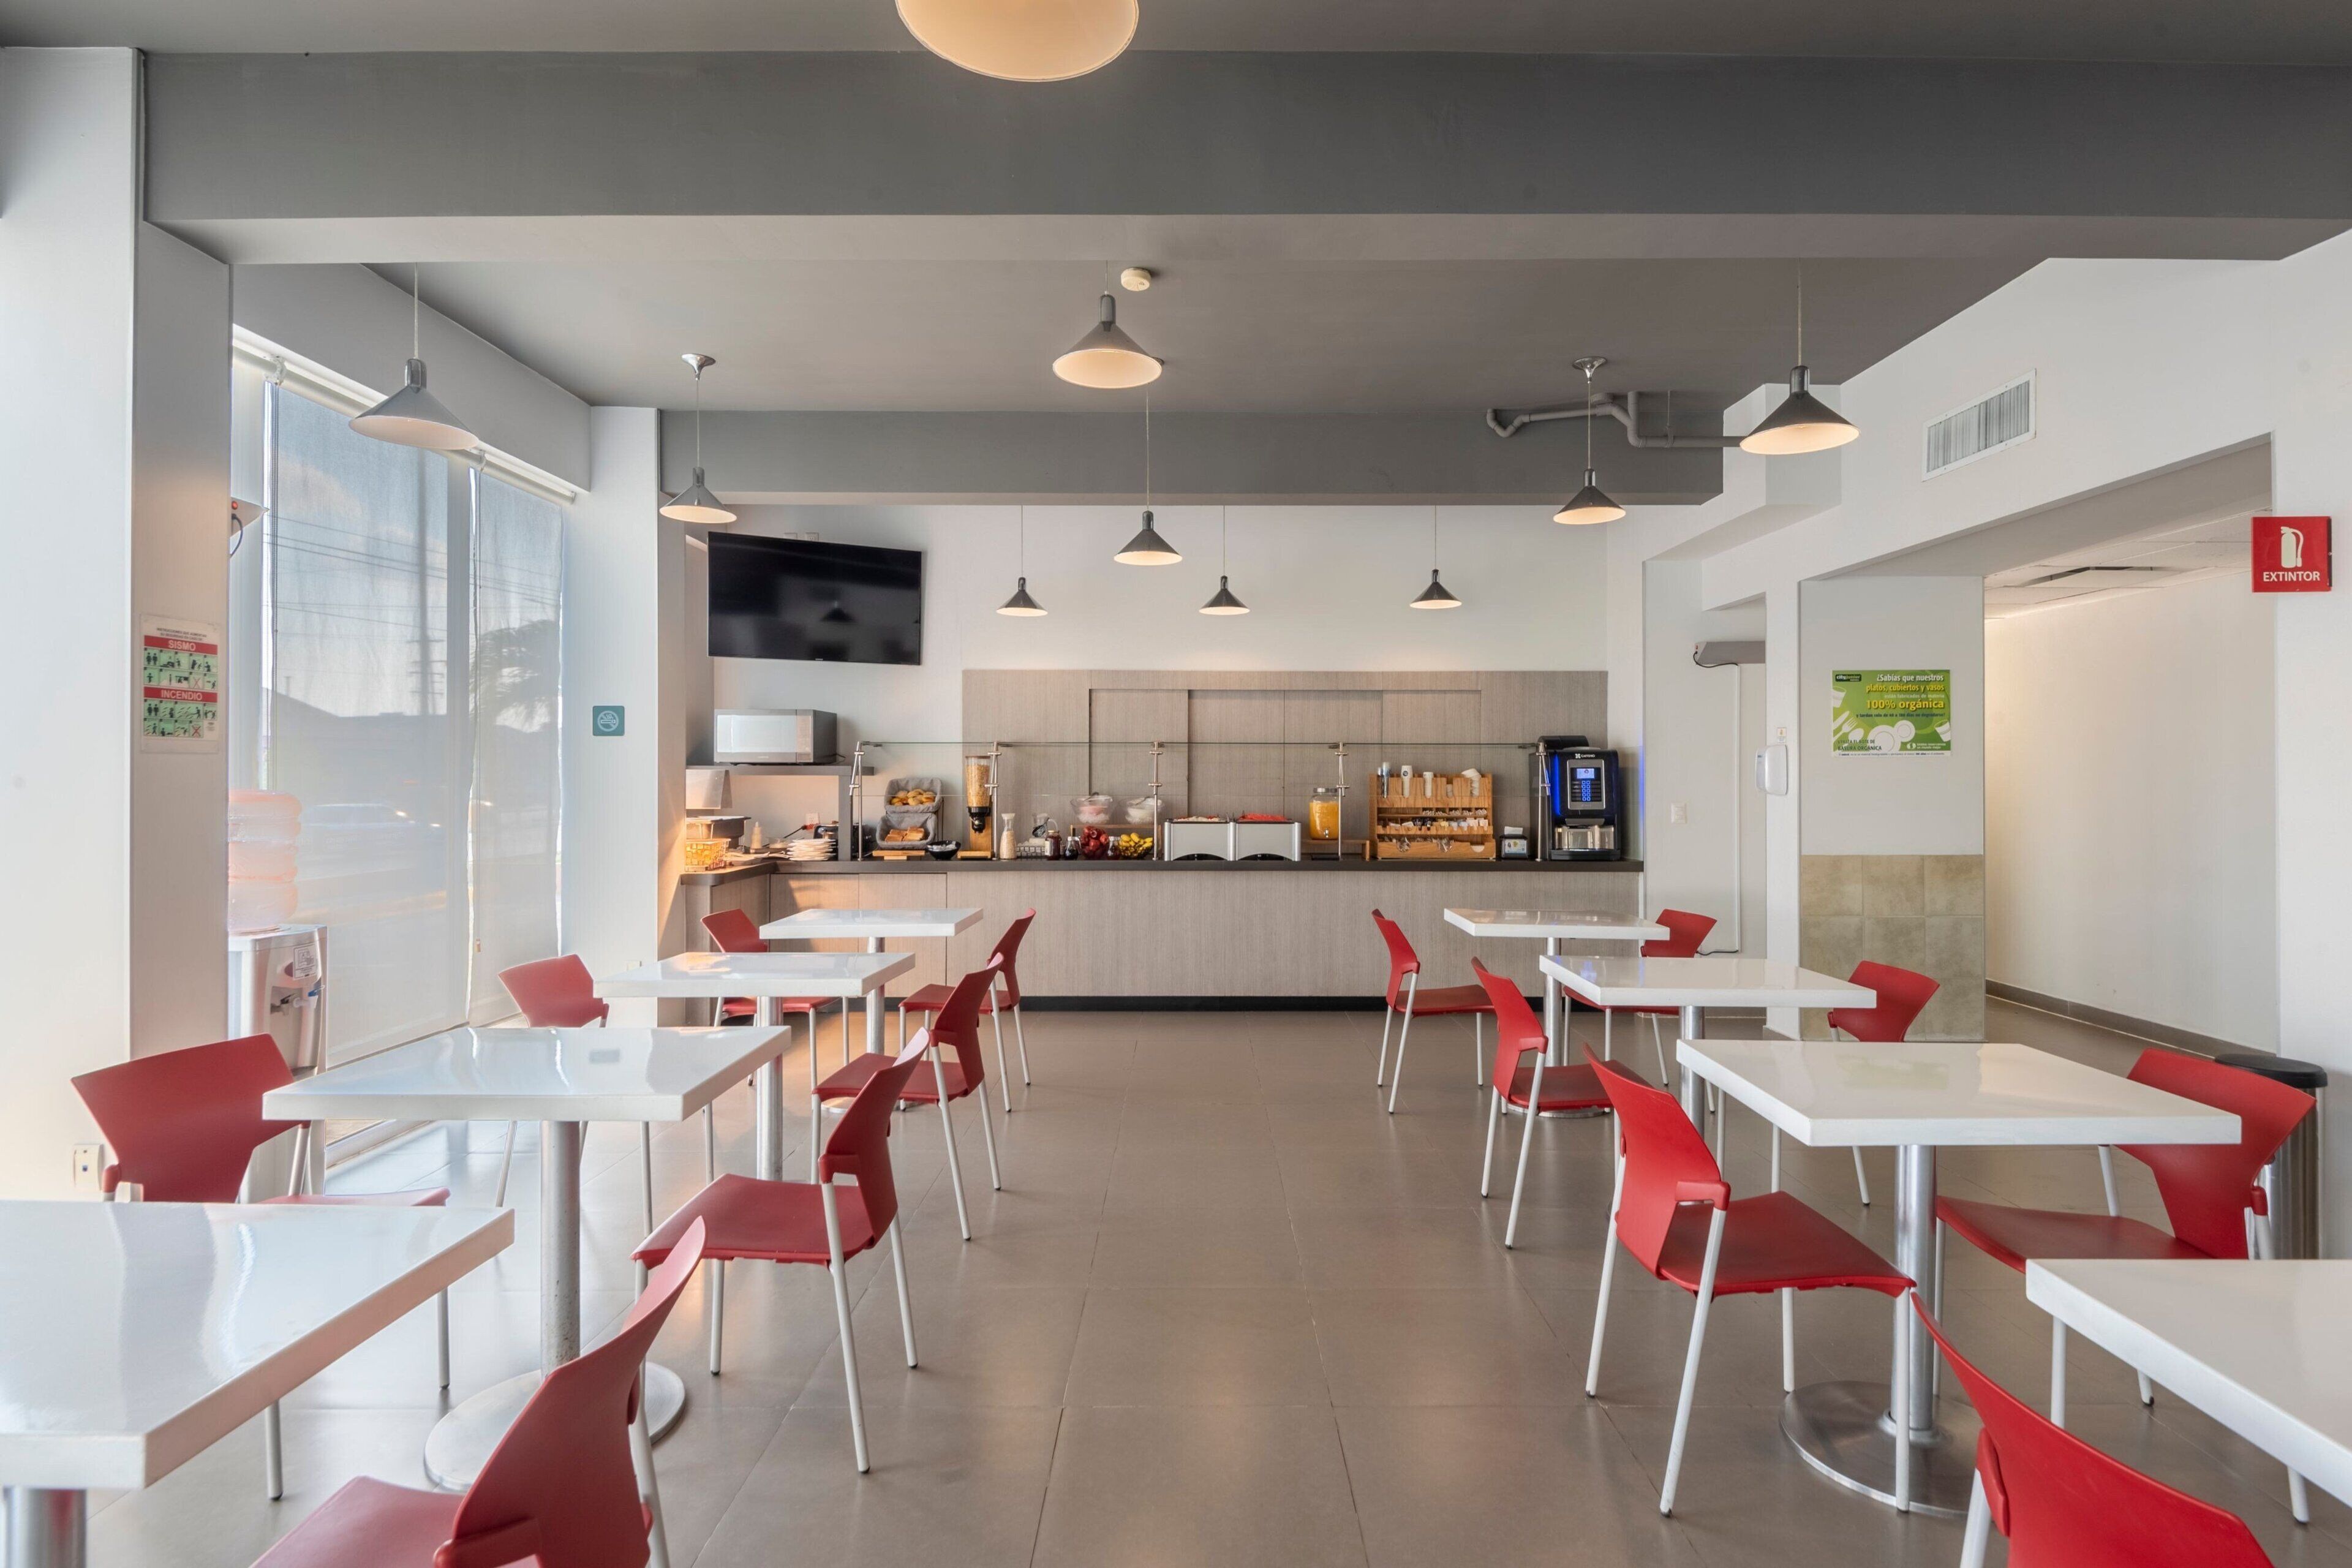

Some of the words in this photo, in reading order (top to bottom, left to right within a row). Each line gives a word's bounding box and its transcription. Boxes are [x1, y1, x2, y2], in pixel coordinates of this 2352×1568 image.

[2263, 571, 2320, 582] EXTINTOR
[168, 639, 196, 651] SISMO
[1877, 673, 1901, 682] ¿Sabías
[1866, 684, 1888, 693] platos,
[161, 689, 203, 701] INCENDIO
[1866, 699, 1896, 709] 100%
[1898, 699, 1944, 711] orgánica
